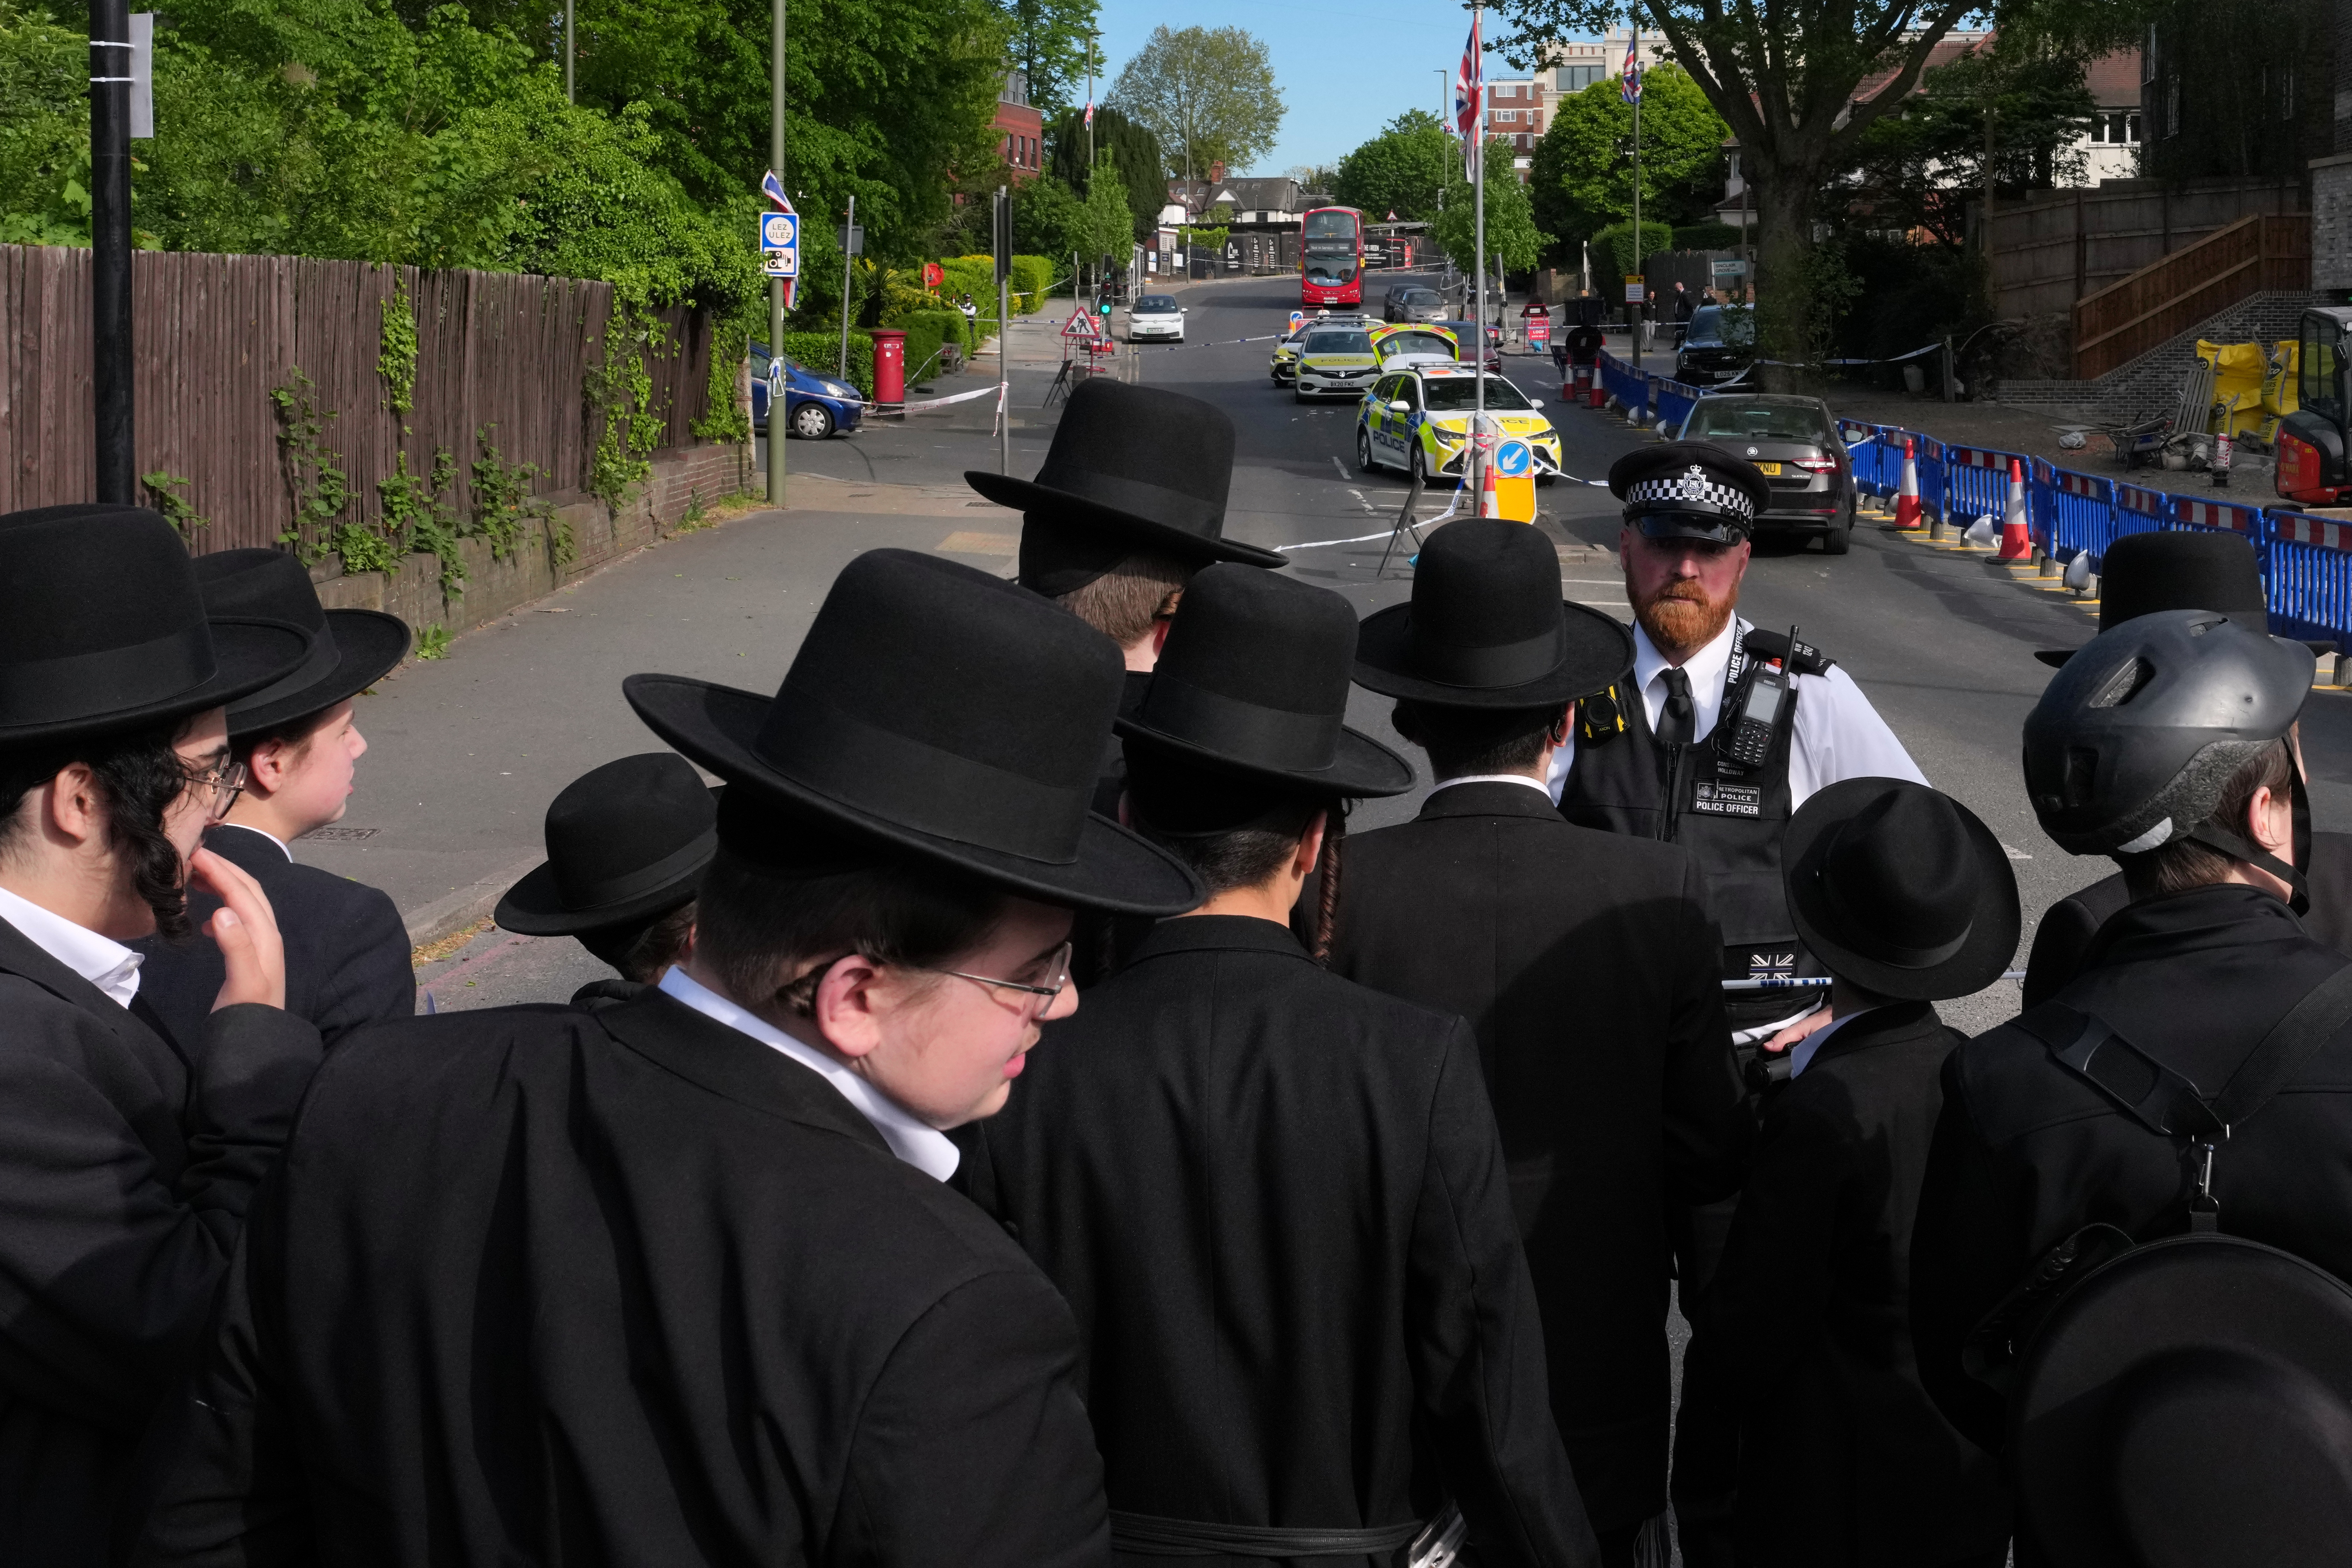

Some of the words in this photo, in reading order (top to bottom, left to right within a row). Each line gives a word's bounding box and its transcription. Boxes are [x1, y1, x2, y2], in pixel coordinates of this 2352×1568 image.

[1373, 430, 1405, 454] POLICE
[1734, 624, 1744, 654] OFFICER
[1794, 642, 1802, 652] NW
[1802, 645, 1814, 657] 1243
[1727, 654, 1742, 684] POLICE
[1717, 761, 1745, 769] CONSTABLE
[1718, 767, 1744, 776] HOLLOWAY
[1718, 786, 1757, 795] METROPOLITAN
[1696, 801, 1724, 811] POLICE
[1726, 803, 1758, 815] OFFICER
